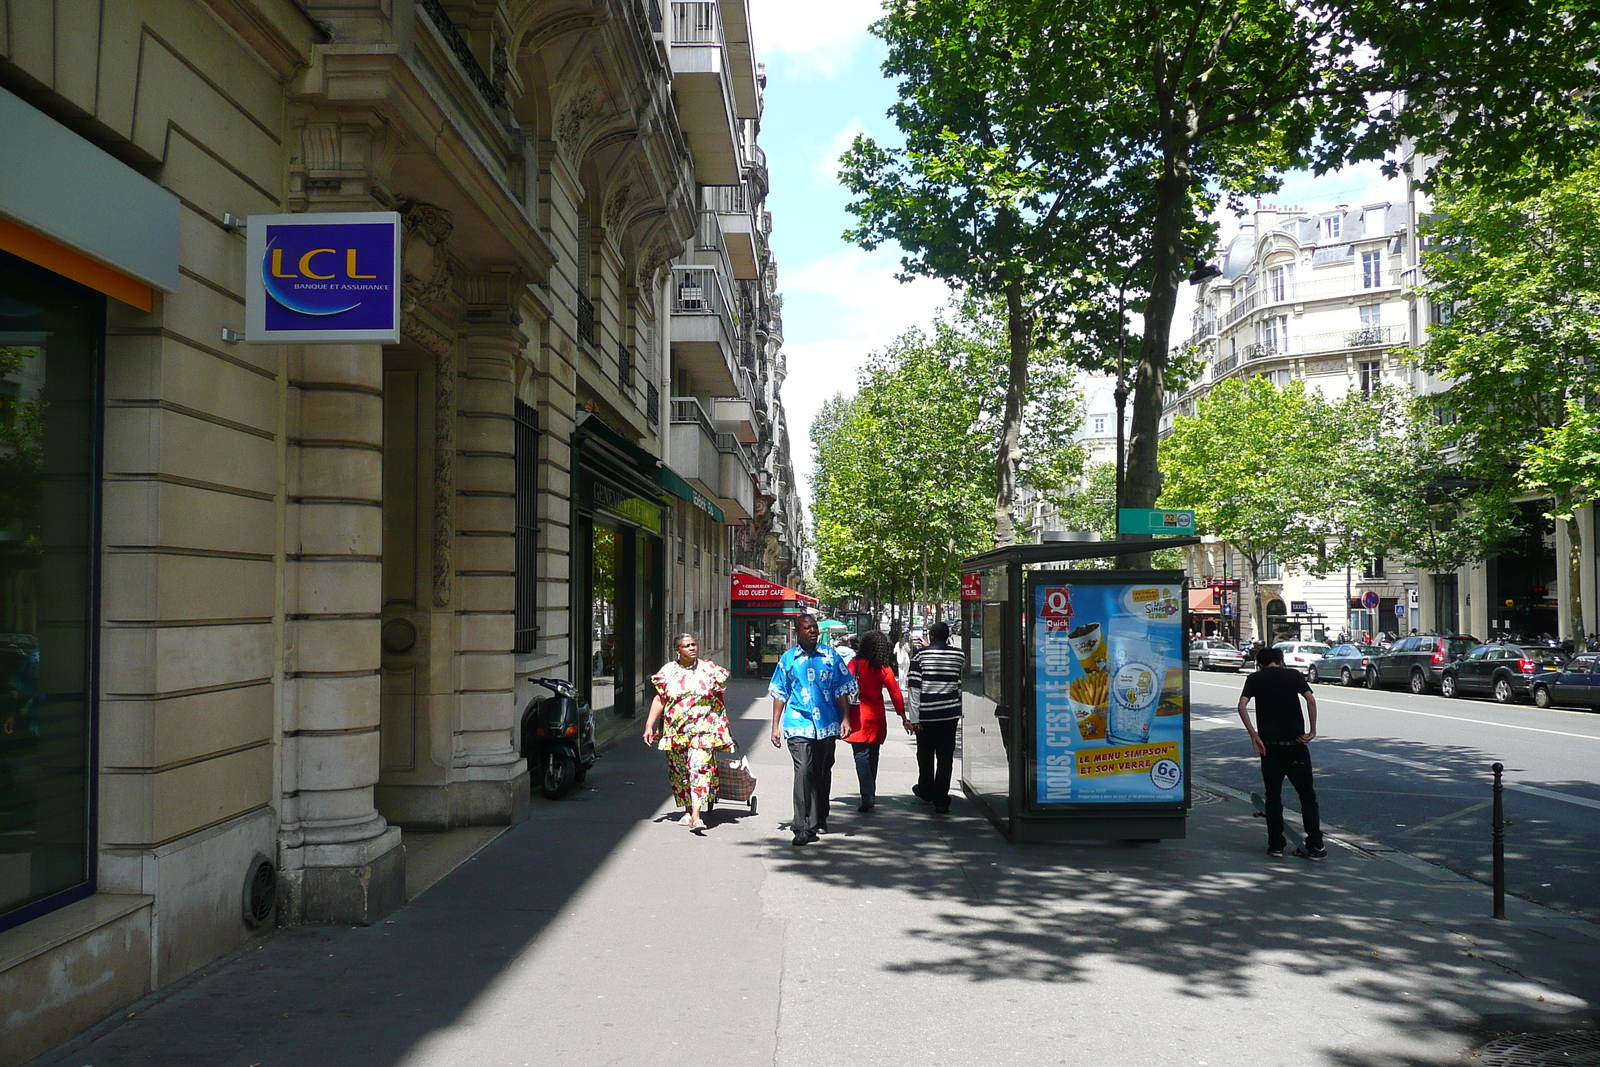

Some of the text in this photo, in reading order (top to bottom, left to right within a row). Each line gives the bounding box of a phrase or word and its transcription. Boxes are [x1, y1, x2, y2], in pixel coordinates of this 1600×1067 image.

[271, 248, 377, 279] LCL
[1040, 634, 1075, 799] NOUS, C'EST LE GOÛT
[1079, 756, 1090, 764] LE
[1093, 752, 1121, 763] MENU
[1080, 759, 1151, 775] ET SON VERRE
[1157, 762, 1177, 778] 6€
